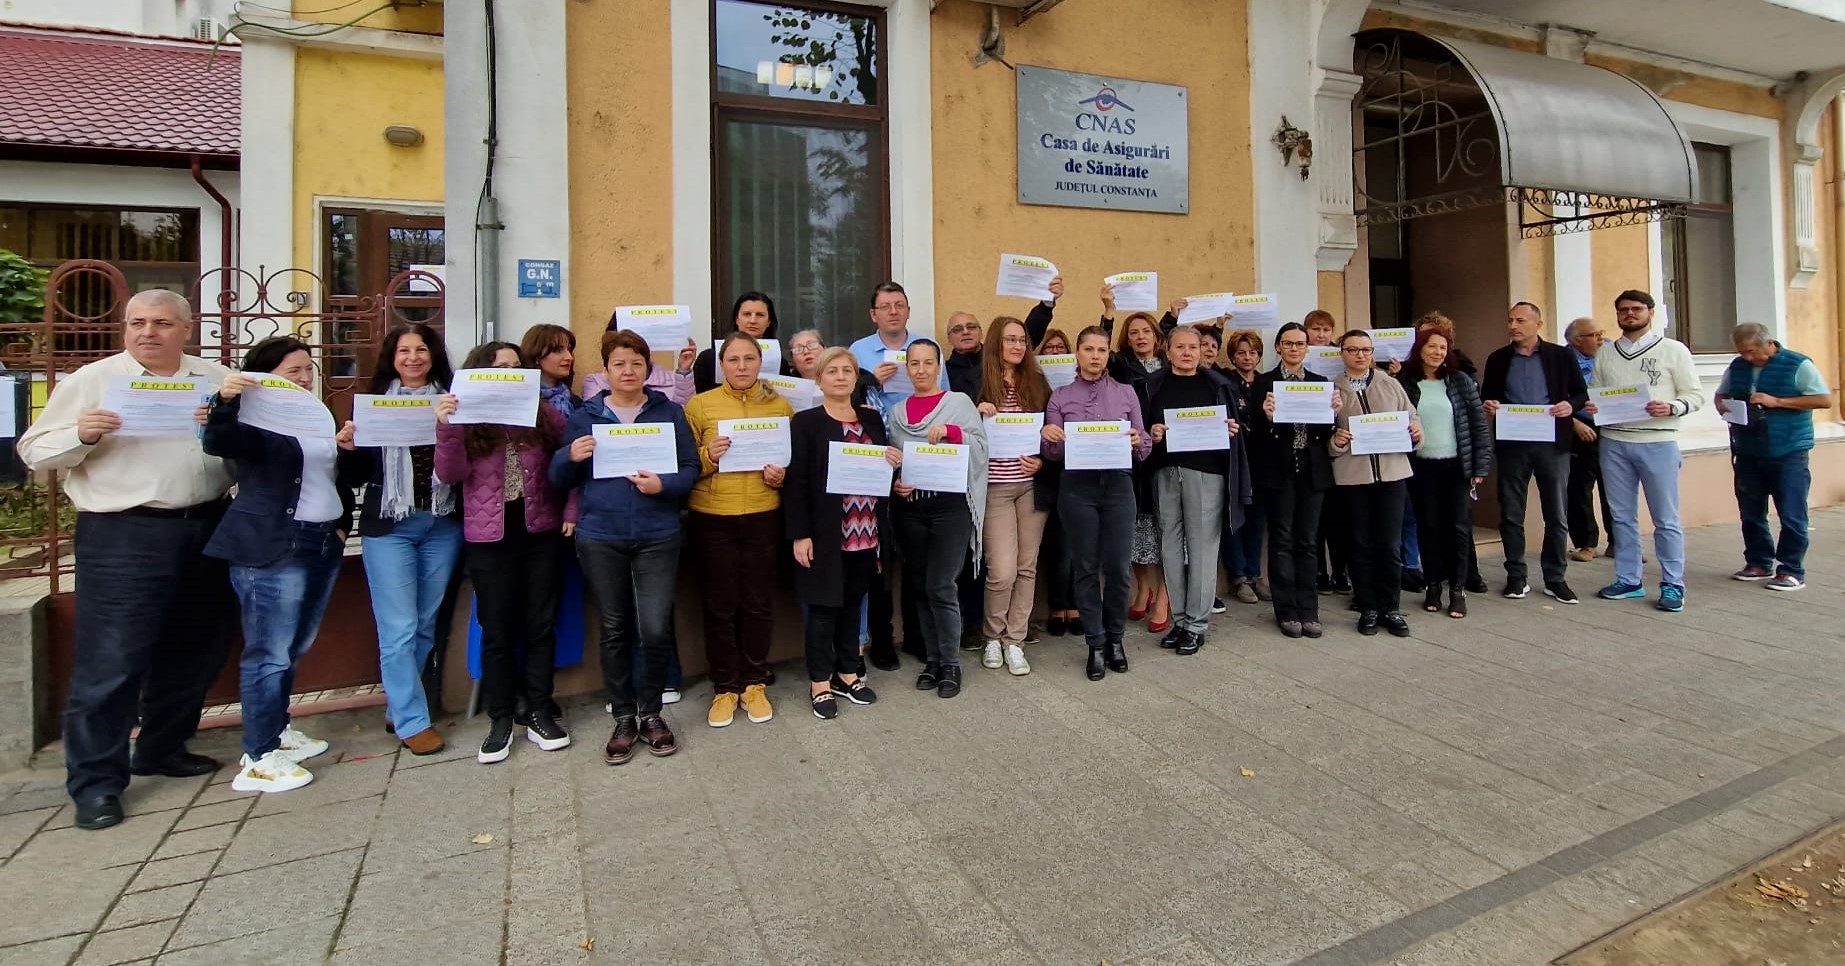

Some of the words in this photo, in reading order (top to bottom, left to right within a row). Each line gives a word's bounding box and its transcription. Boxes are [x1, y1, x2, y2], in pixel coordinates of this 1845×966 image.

[1075, 112, 1136, 135] CNAS
[1040, 133, 1078, 151] Casa
[1082, 137, 1100, 153] de
[1102, 140, 1170, 160] Asigurări
[1064, 157, 1082, 174] de
[1086, 159, 1149, 179] Sănătate
[526, 268, 553, 280] G.N.
[131, 382, 196, 390] PROTEST
[372, 399, 432, 407] PROTEST
[609, 427, 661, 436] PROTEST
[733, 422, 779, 431] PROTEST
